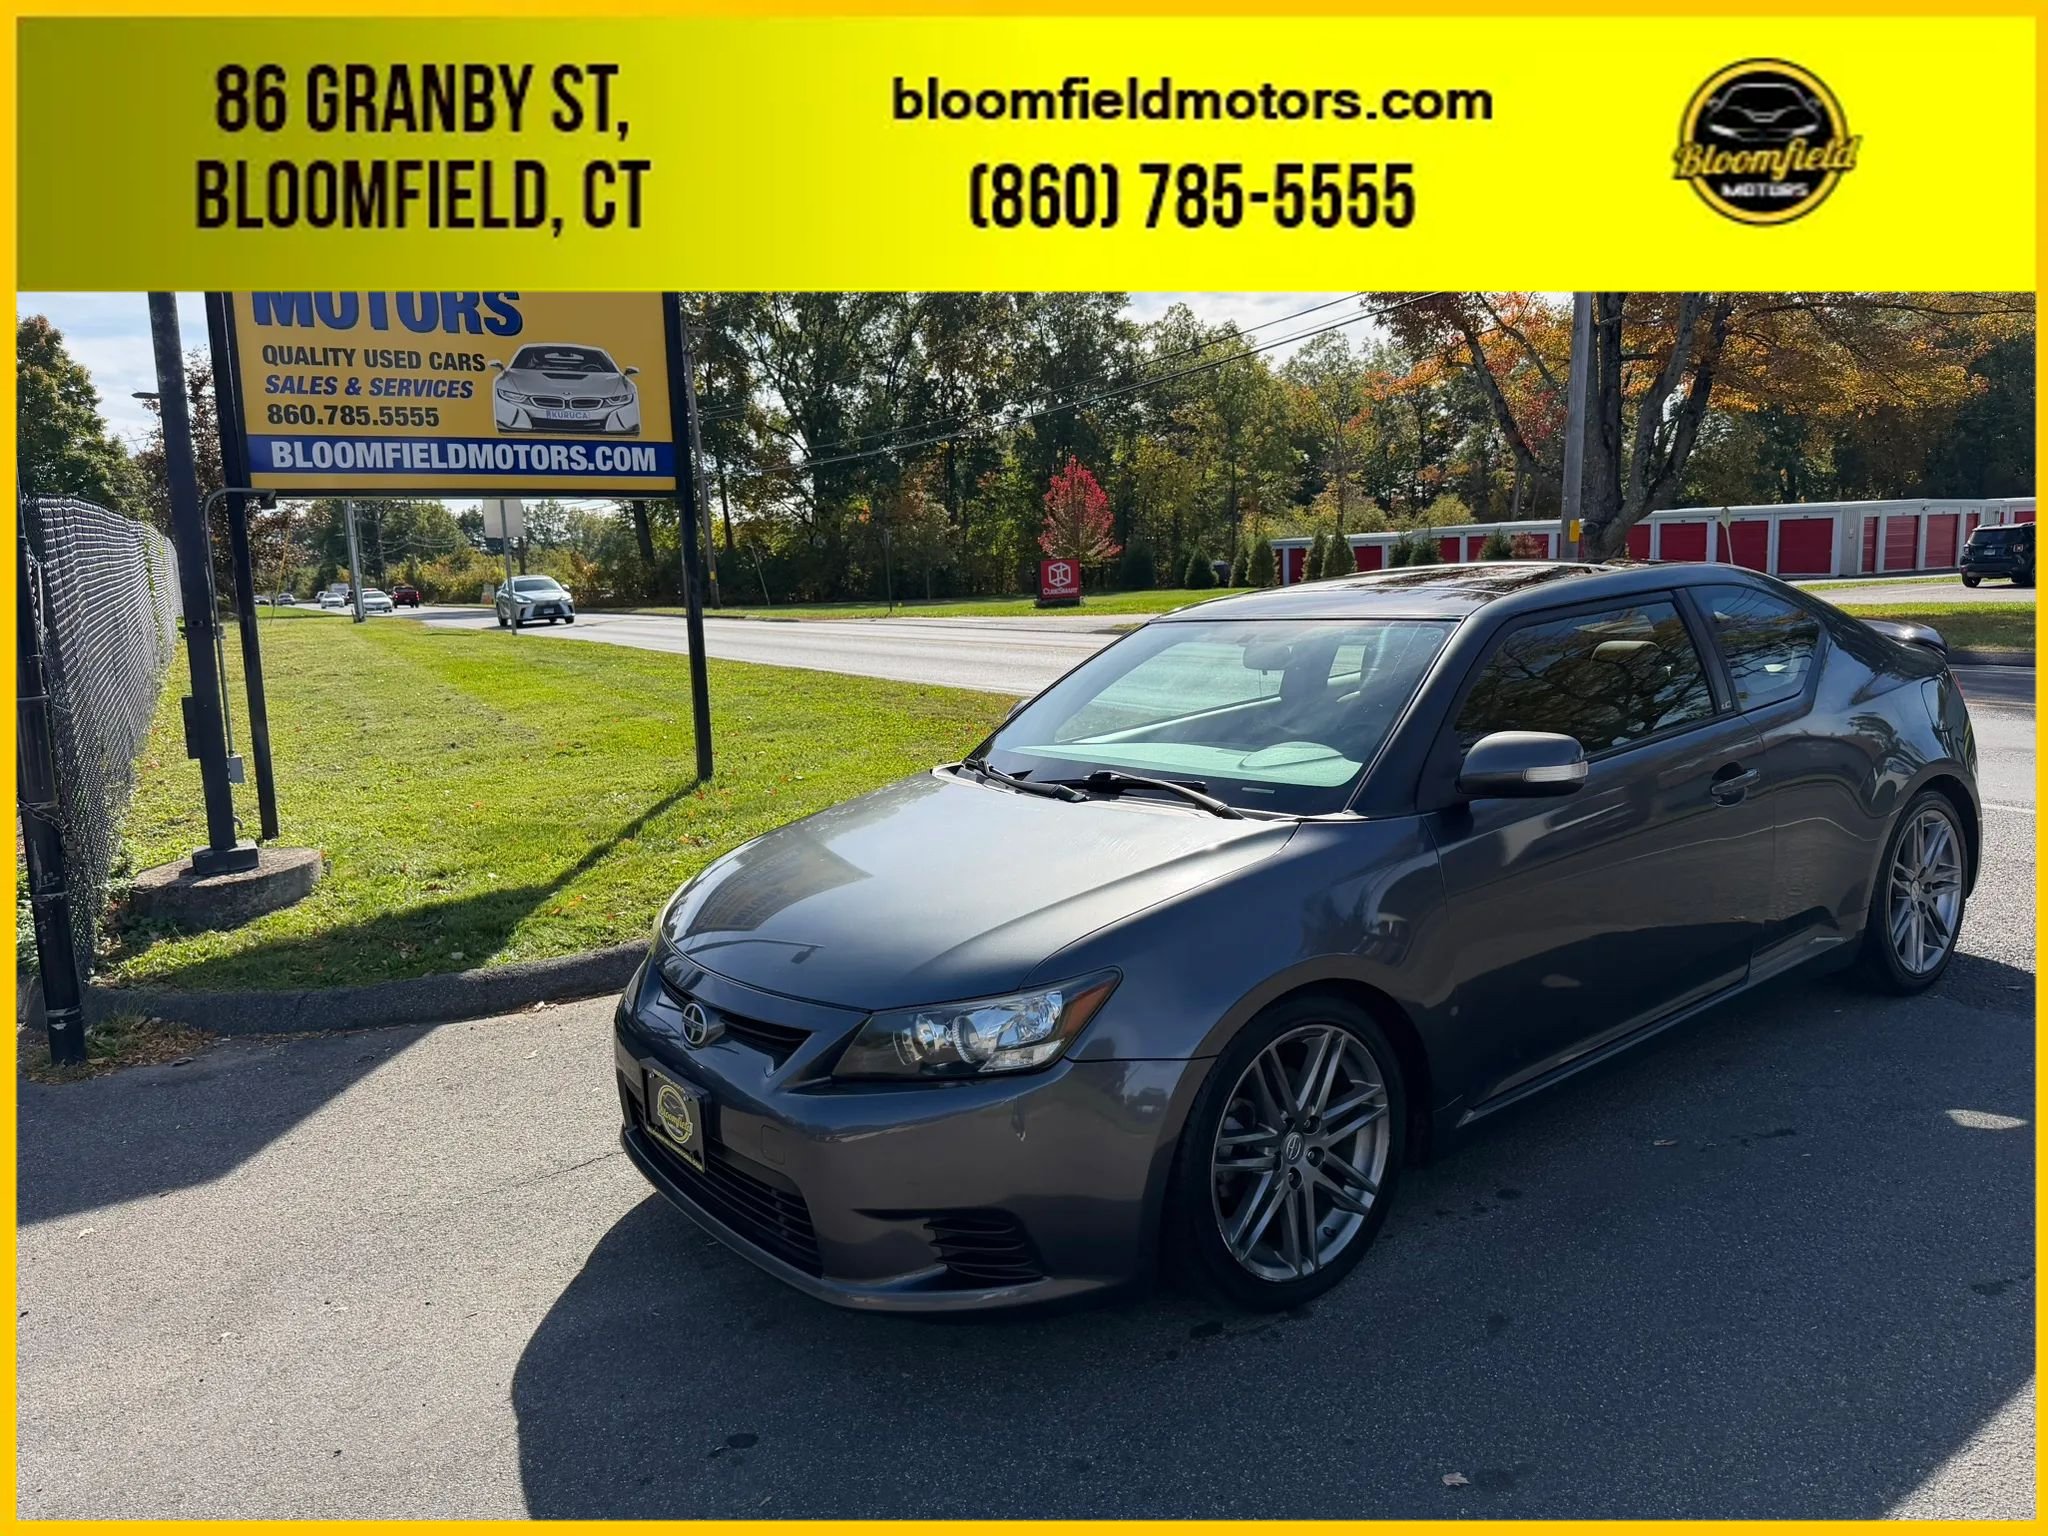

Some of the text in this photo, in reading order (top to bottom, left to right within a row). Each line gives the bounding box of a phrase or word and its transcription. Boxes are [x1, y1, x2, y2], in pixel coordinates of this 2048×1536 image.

[262, 344, 486, 372] QUALITY USED CARS
[265, 374, 474, 399] SALES & SERVICES
[267, 403, 440, 427] 860.785.5555
[271, 441, 657, 472] BLOOMFIELDMOTORS.COM
